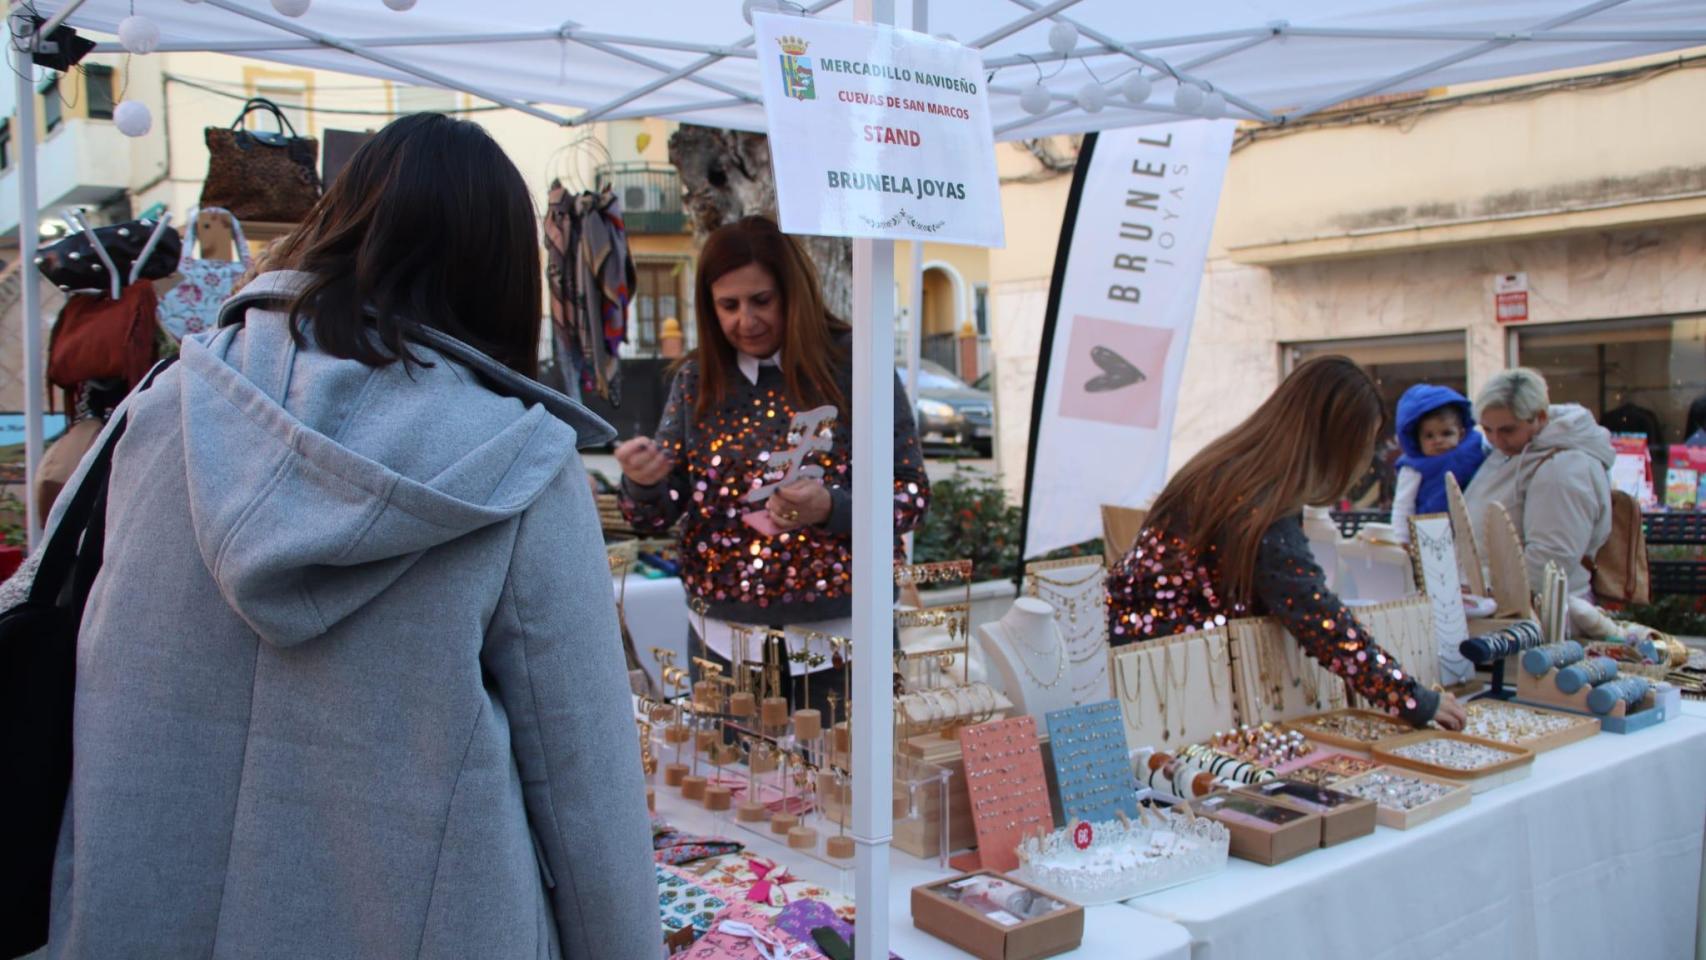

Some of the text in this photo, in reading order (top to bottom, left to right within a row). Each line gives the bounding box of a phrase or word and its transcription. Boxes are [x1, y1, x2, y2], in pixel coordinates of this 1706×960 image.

[820, 58, 977, 95] MERCADILLO NAVIDEÑO
[838, 90, 970, 120] CUEVAS DE SAN MARCOS
[864, 125, 921, 147] STAND
[827, 170, 966, 201] BRUNELA JOYAS
[1154, 162, 1189, 267] JOYAS
